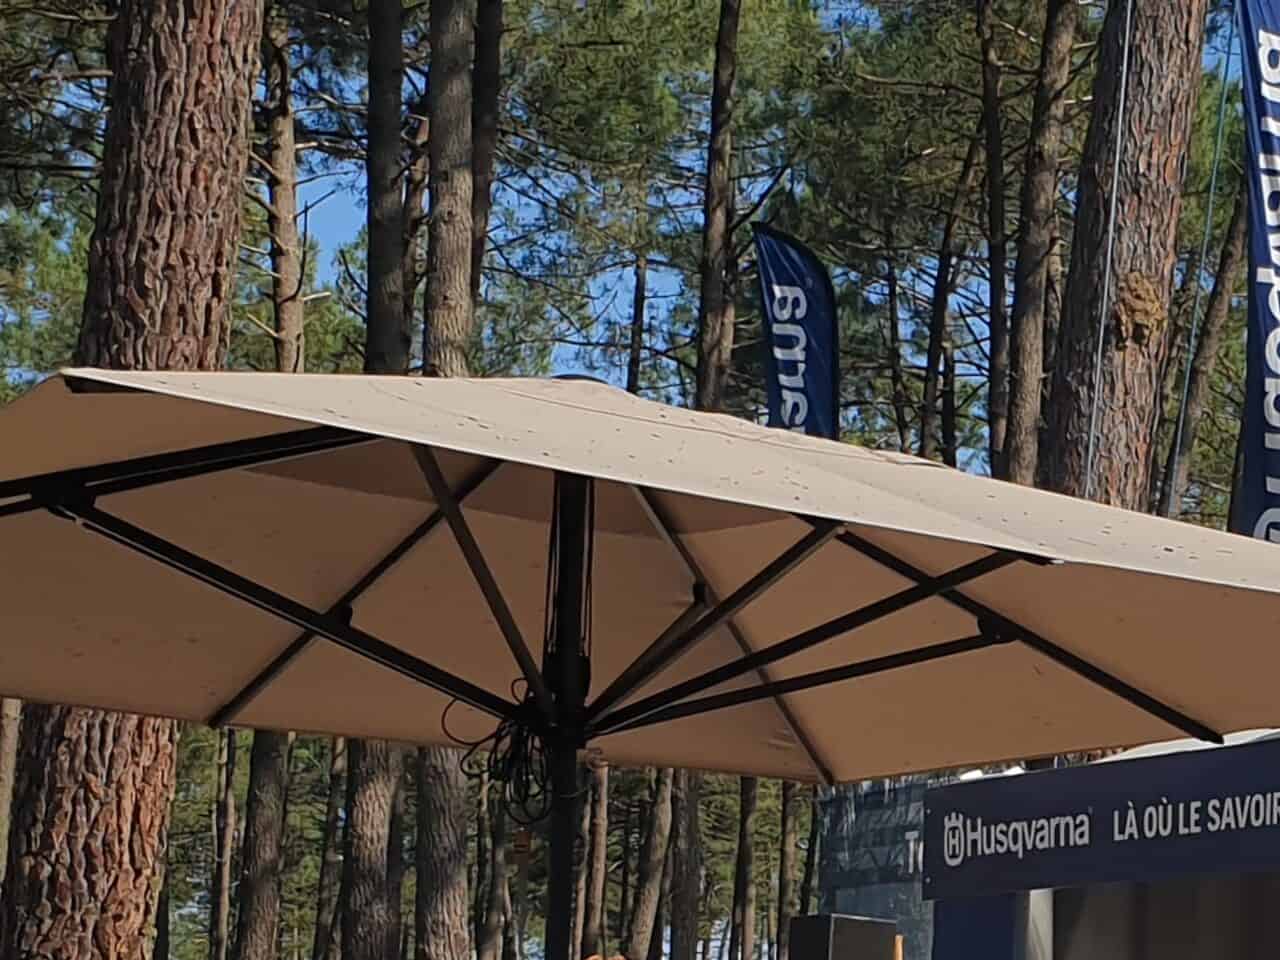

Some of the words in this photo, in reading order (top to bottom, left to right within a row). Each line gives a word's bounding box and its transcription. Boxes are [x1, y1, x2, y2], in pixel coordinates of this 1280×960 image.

[966, 813, 1090, 860] Husqvarna
[1113, 801, 1139, 841] LÀ
[1143, 797, 1173, 838] OÙ
[1178, 801, 1201, 835] LE
